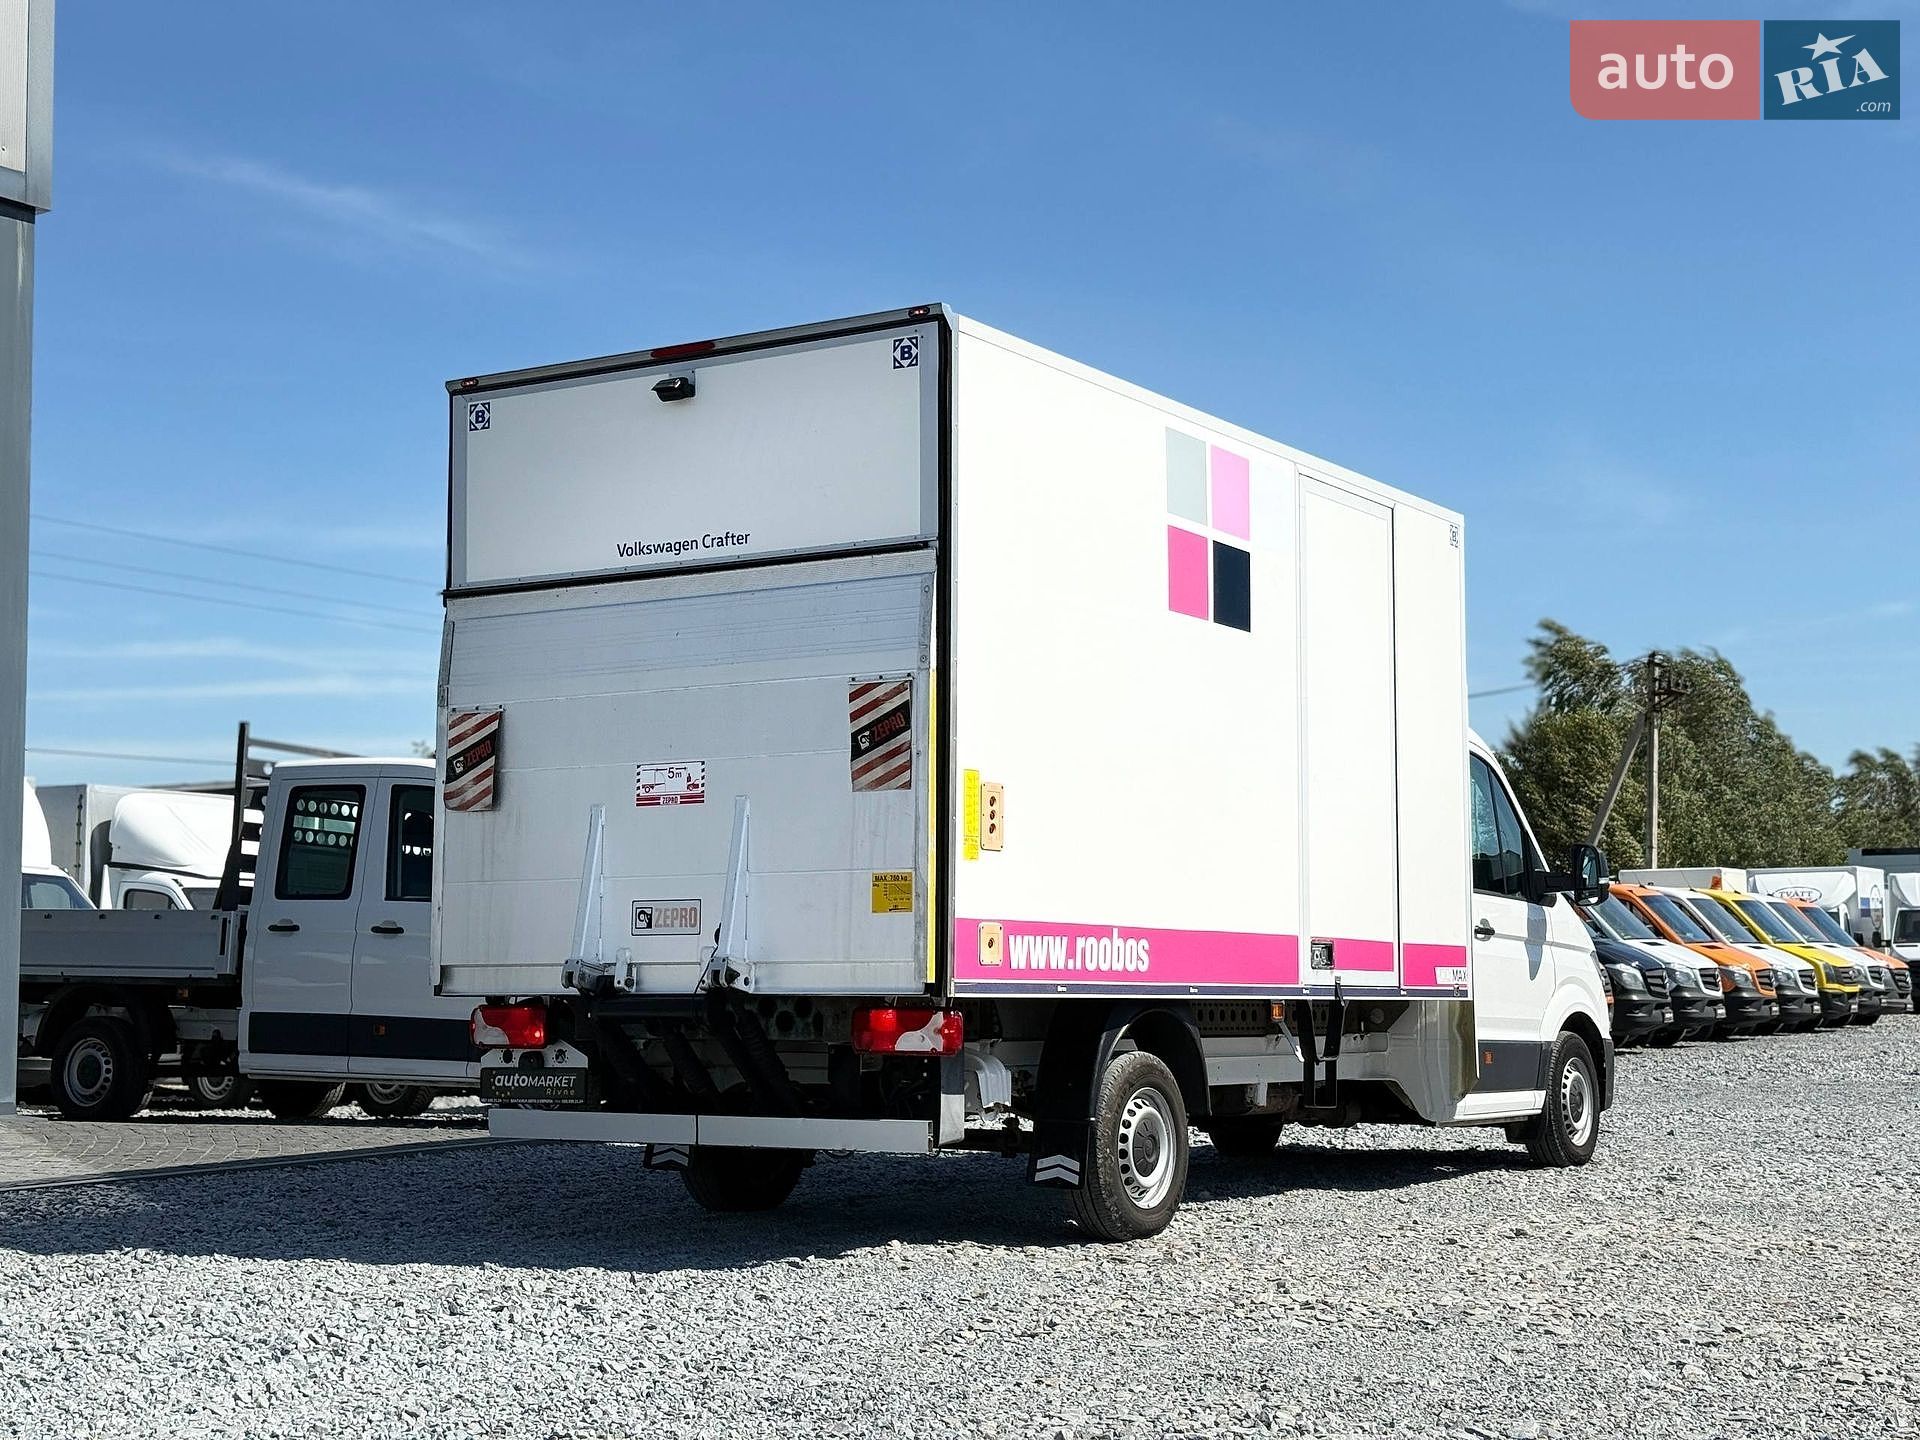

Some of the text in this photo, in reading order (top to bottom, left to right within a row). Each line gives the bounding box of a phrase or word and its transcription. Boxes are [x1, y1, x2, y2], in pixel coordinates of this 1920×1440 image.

[900, 344, 913, 361] B
[475, 409, 486, 424] B
[617, 531, 751, 558] Volkswagen Crafter
[873, 712, 906, 742] ZEPRO
[466, 740, 493, 766] ZEPRO
[654, 907, 697, 928] ZEPRO
[1008, 927, 1151, 973] www.roobos
[494, 1073, 576, 1087] autoMARKET
